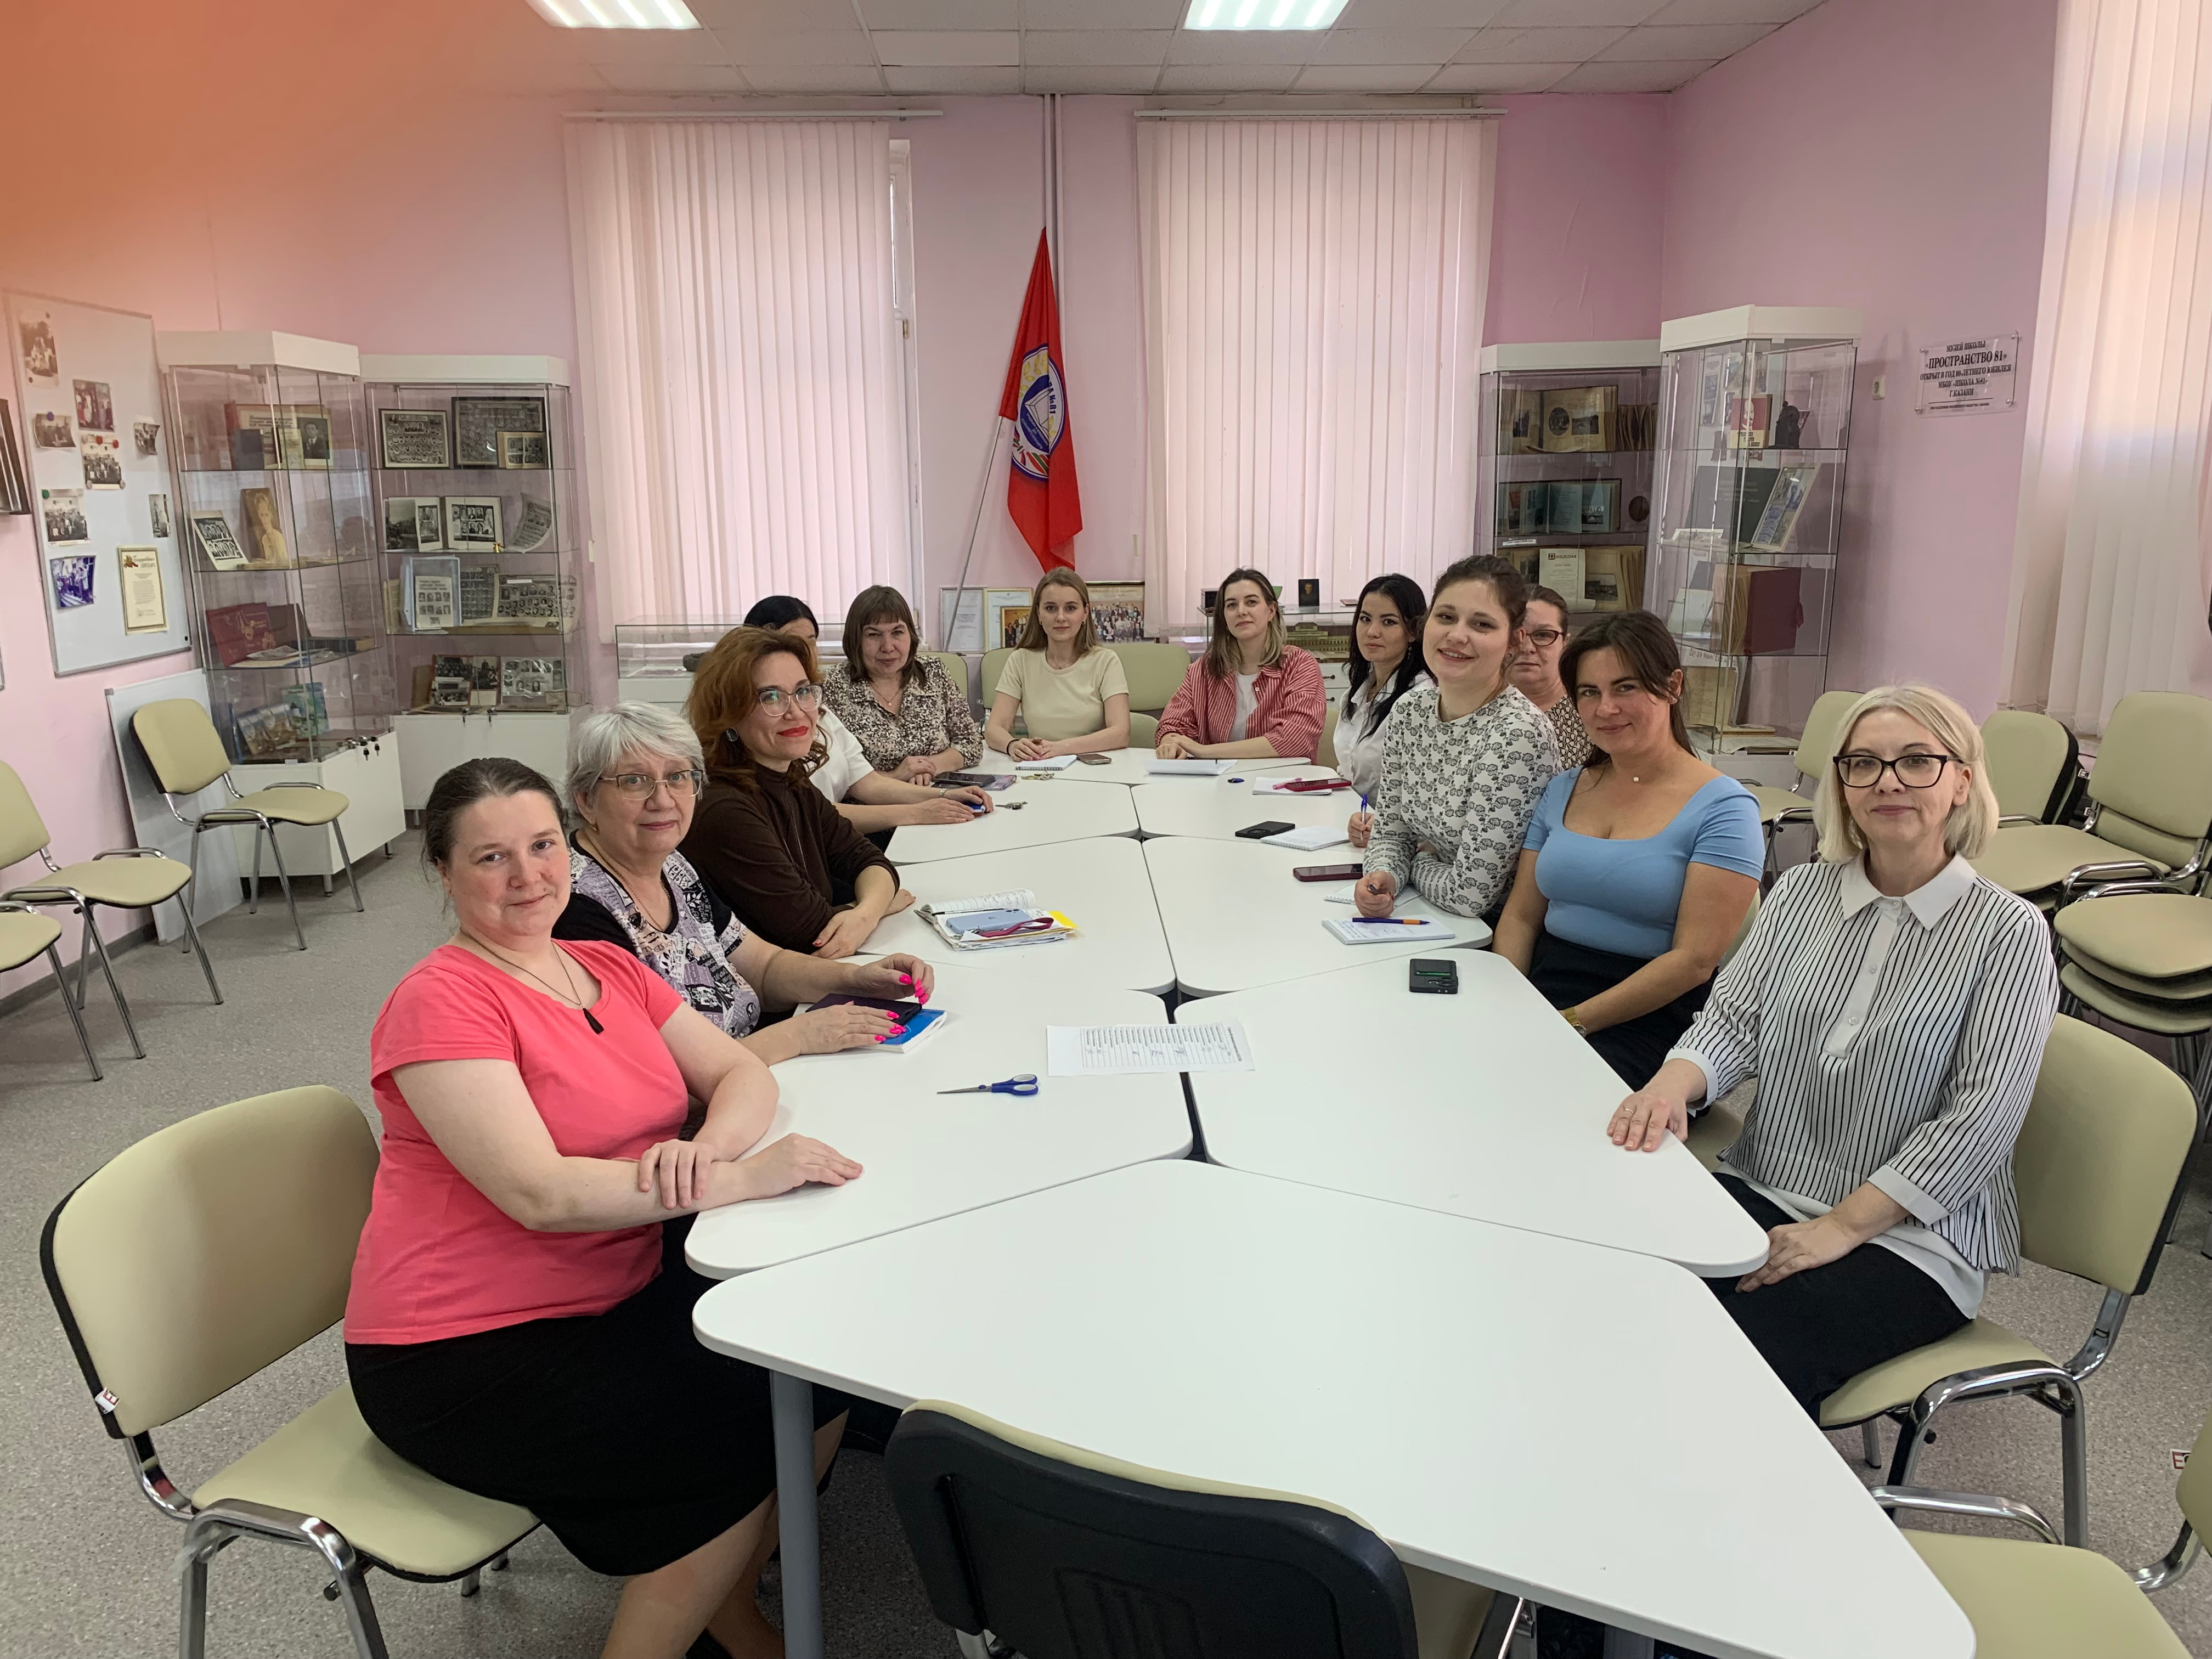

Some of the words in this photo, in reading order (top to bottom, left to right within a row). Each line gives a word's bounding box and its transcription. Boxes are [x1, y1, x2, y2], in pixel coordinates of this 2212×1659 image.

[1946, 342, 1963, 352] МУЗЕЙ
[1964, 340, 1985, 350] ШКОЛЫ
[1926, 351, 1992, 369] «ПРОСТРАНСТВО
[1994, 350, 2007, 362] 81»
[1920, 372, 1940, 380] ОТКРЫТ
[1987, 364, 2011, 374] ЮБИЛЕЯ
[1938, 380, 1952, 388] МБОУ
